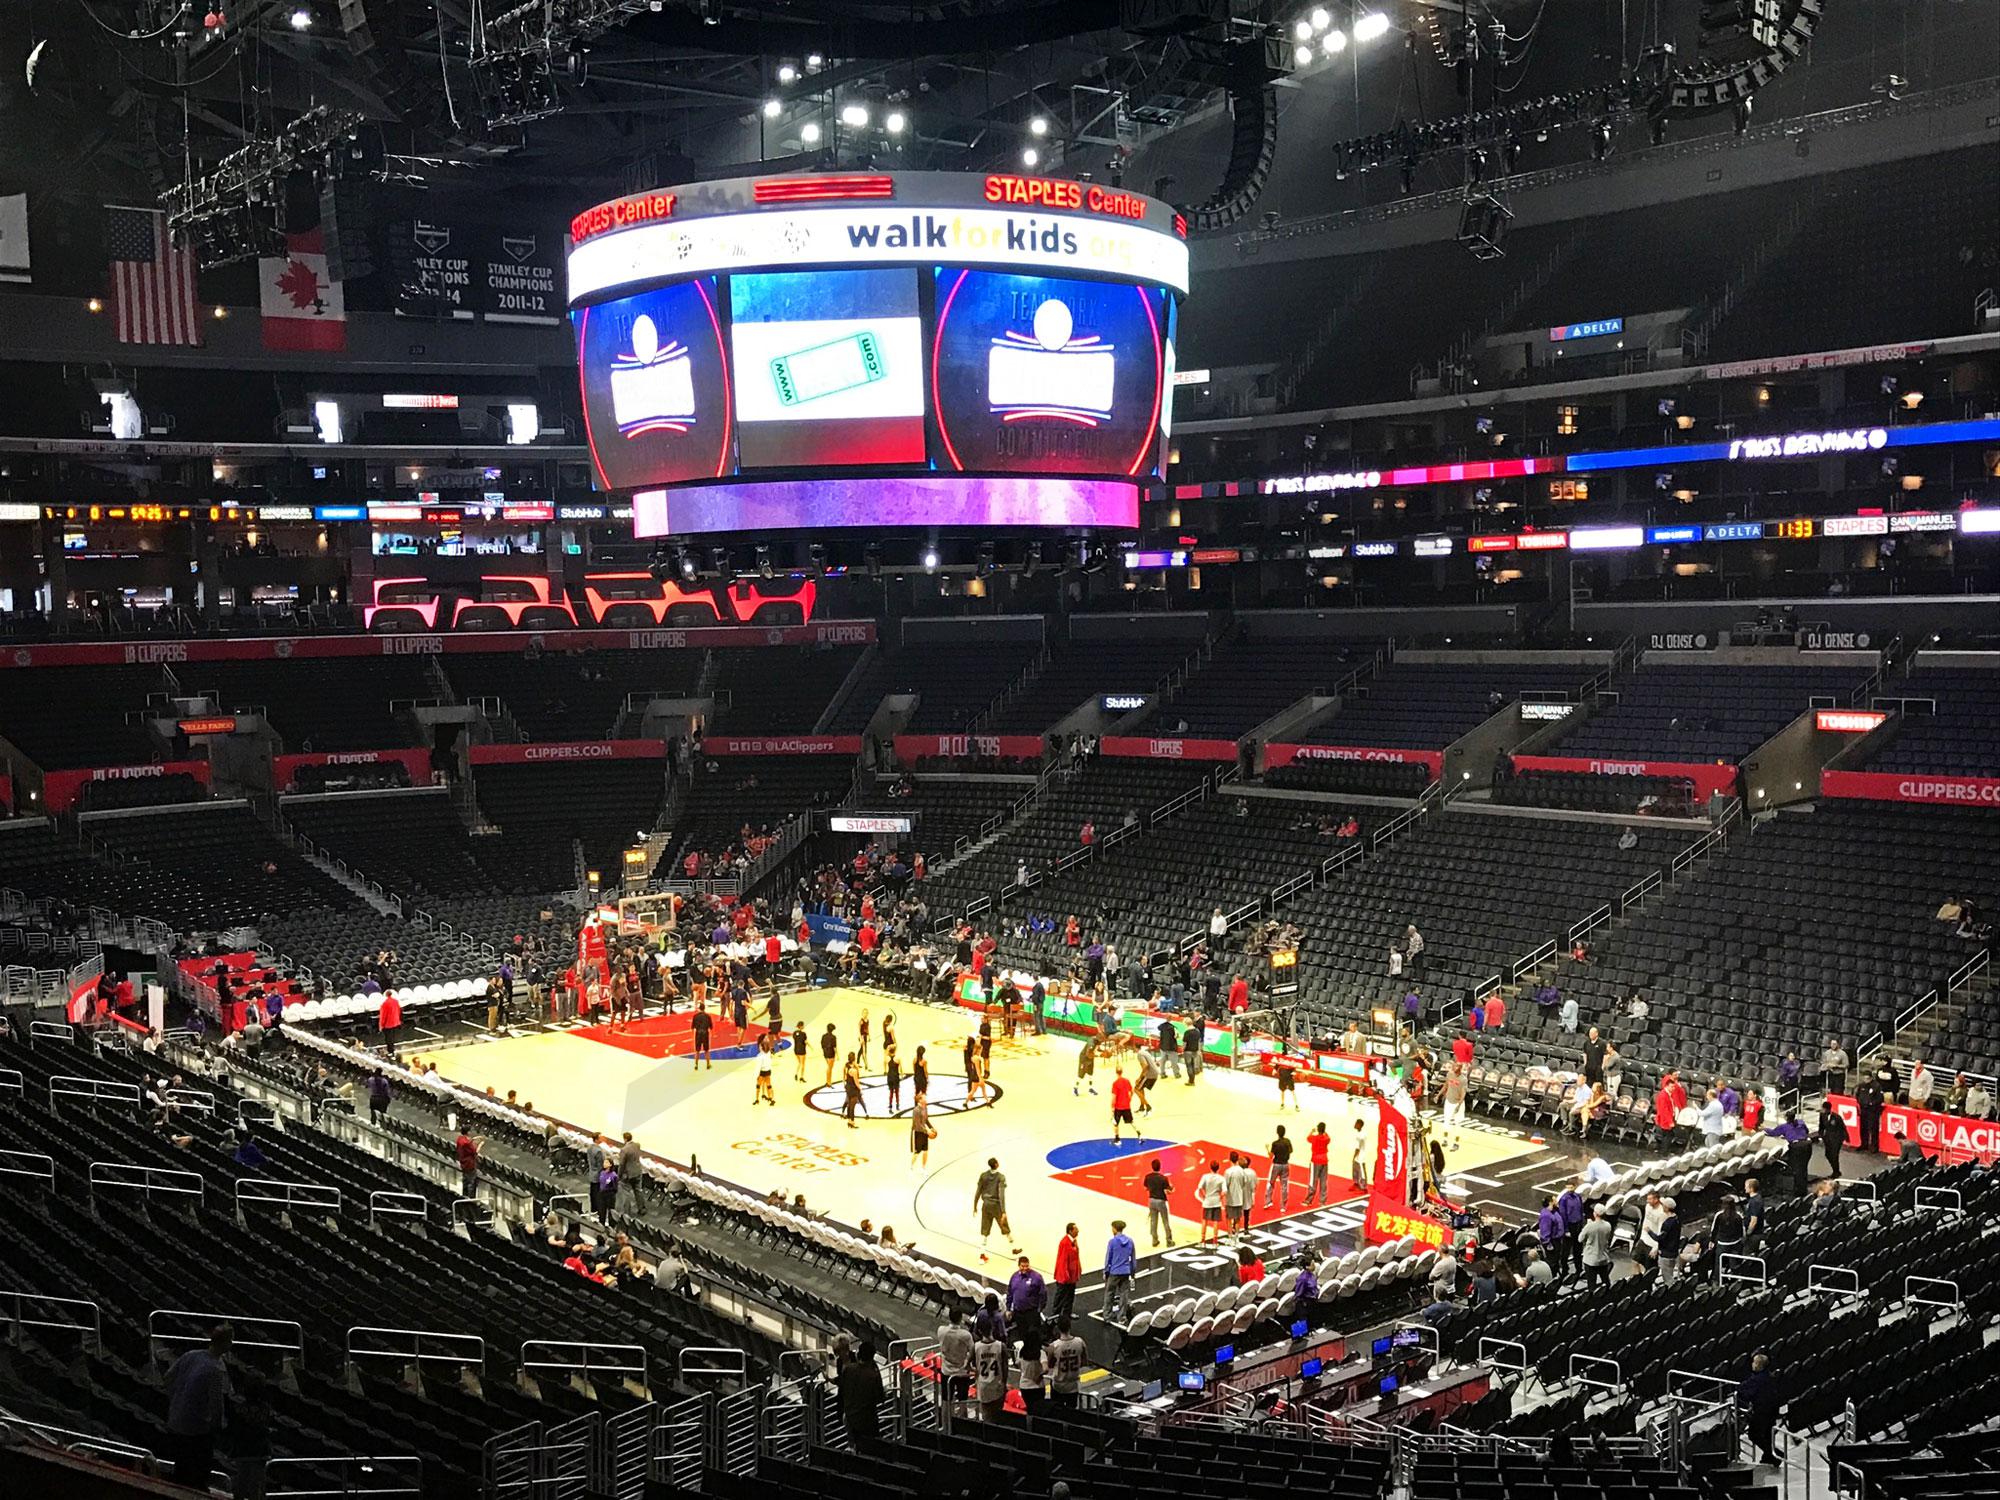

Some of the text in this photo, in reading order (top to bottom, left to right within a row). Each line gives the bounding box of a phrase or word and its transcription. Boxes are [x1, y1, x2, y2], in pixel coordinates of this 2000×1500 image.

[984, 176, 1147, 219] STAPLES Center
[571, 193, 676, 245] STAPLES Center
[446, 259, 468, 271] CUP
[487, 263, 553, 278] STANLEY CUP
[488, 276, 554, 292] CHAMPIONS
[498, 294, 546, 311] 2011-12
[1583, 321, 1619, 334] DELTA
[861, 338, 880, 375] .com
[775, 363, 793, 402] www
[561, 508, 602, 518] StubHub
[1890, 514, 1956, 526] SAN MANUEL
[1718, 526, 1761, 538] DELTA
[1778, 520, 1813, 538] 11:33
[1826, 519, 1885, 534] STAPLES
[1518, 535, 1567, 548] TOSHIBA
[1355, 544, 1395, 556] StubHub
[640, 632, 686, 648] CLIPPERS
[828, 627, 866, 641] CLIPPERS
[1651, 634, 1693, 649] DJ DENSE
[1808, 633, 1855, 648] DJ DENSE
[395, 637, 443, 654] CLIPPERS
[138, 644, 187, 663] CLIPPERS
[525, 745, 612, 759] CLIPPERS.COM
[765, 740, 834, 754] @LAClippers
[1150, 740, 1183, 755] CLIPPERS
[846, 820, 896, 831] STAPLES
[765, 1133, 869, 1166] STAPLES
[731, 1141, 831, 1174] Center
[1375, 1211, 1445, 1248] 龙发装饰
[979, 1360, 999, 1377] 24
